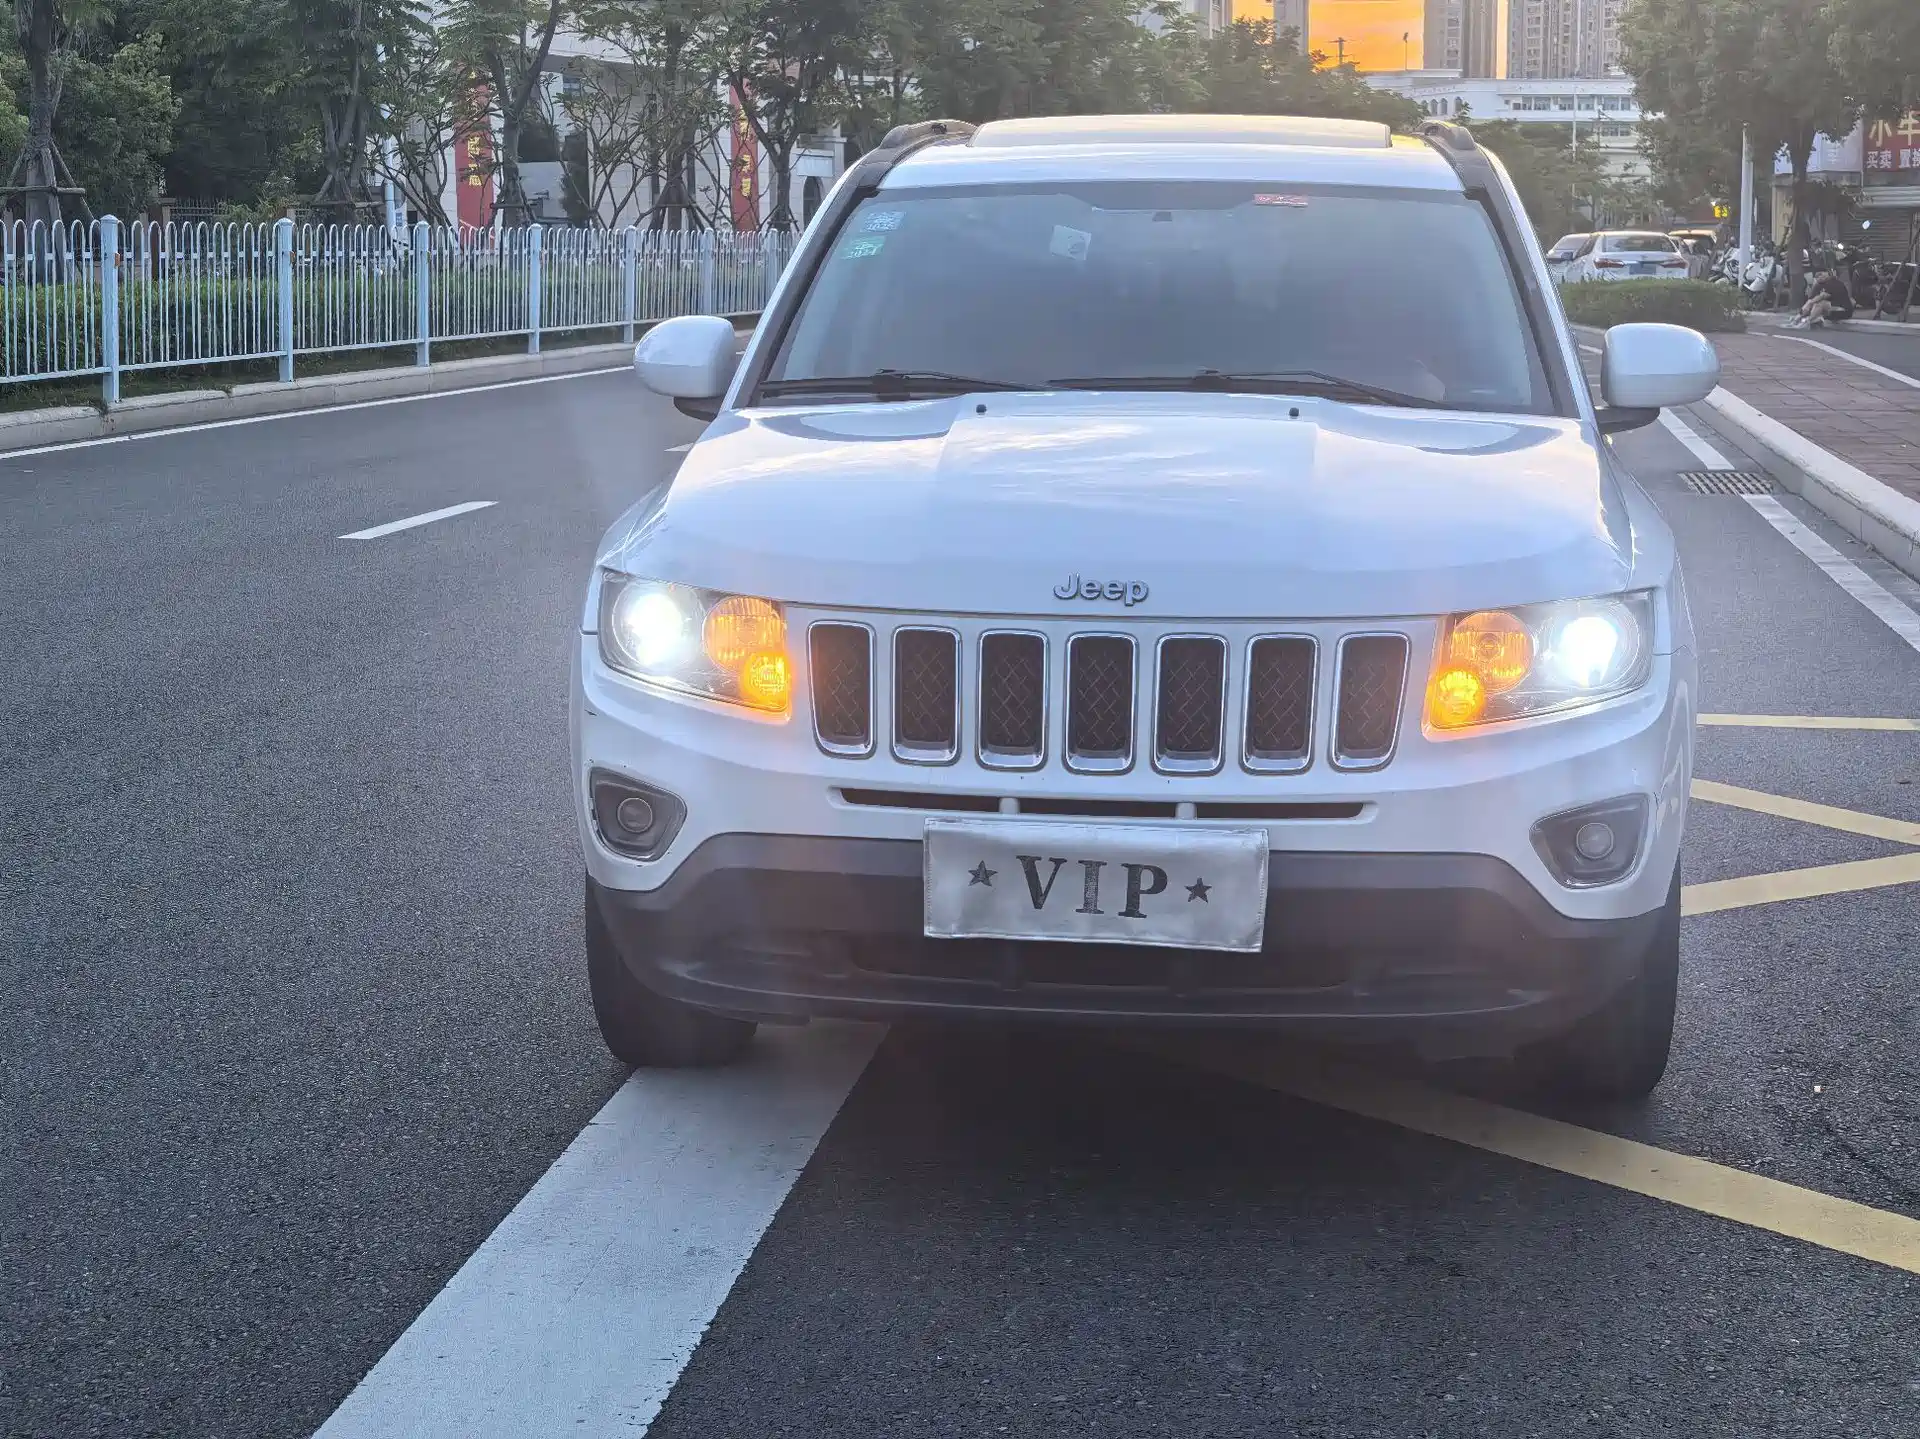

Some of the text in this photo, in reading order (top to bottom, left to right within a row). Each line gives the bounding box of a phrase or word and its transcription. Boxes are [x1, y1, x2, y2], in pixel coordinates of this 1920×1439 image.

[1866, 149, 1892, 169] 买卖
[1053, 572, 1149, 607] Jeep
[1016, 855, 1168, 918] VIP
